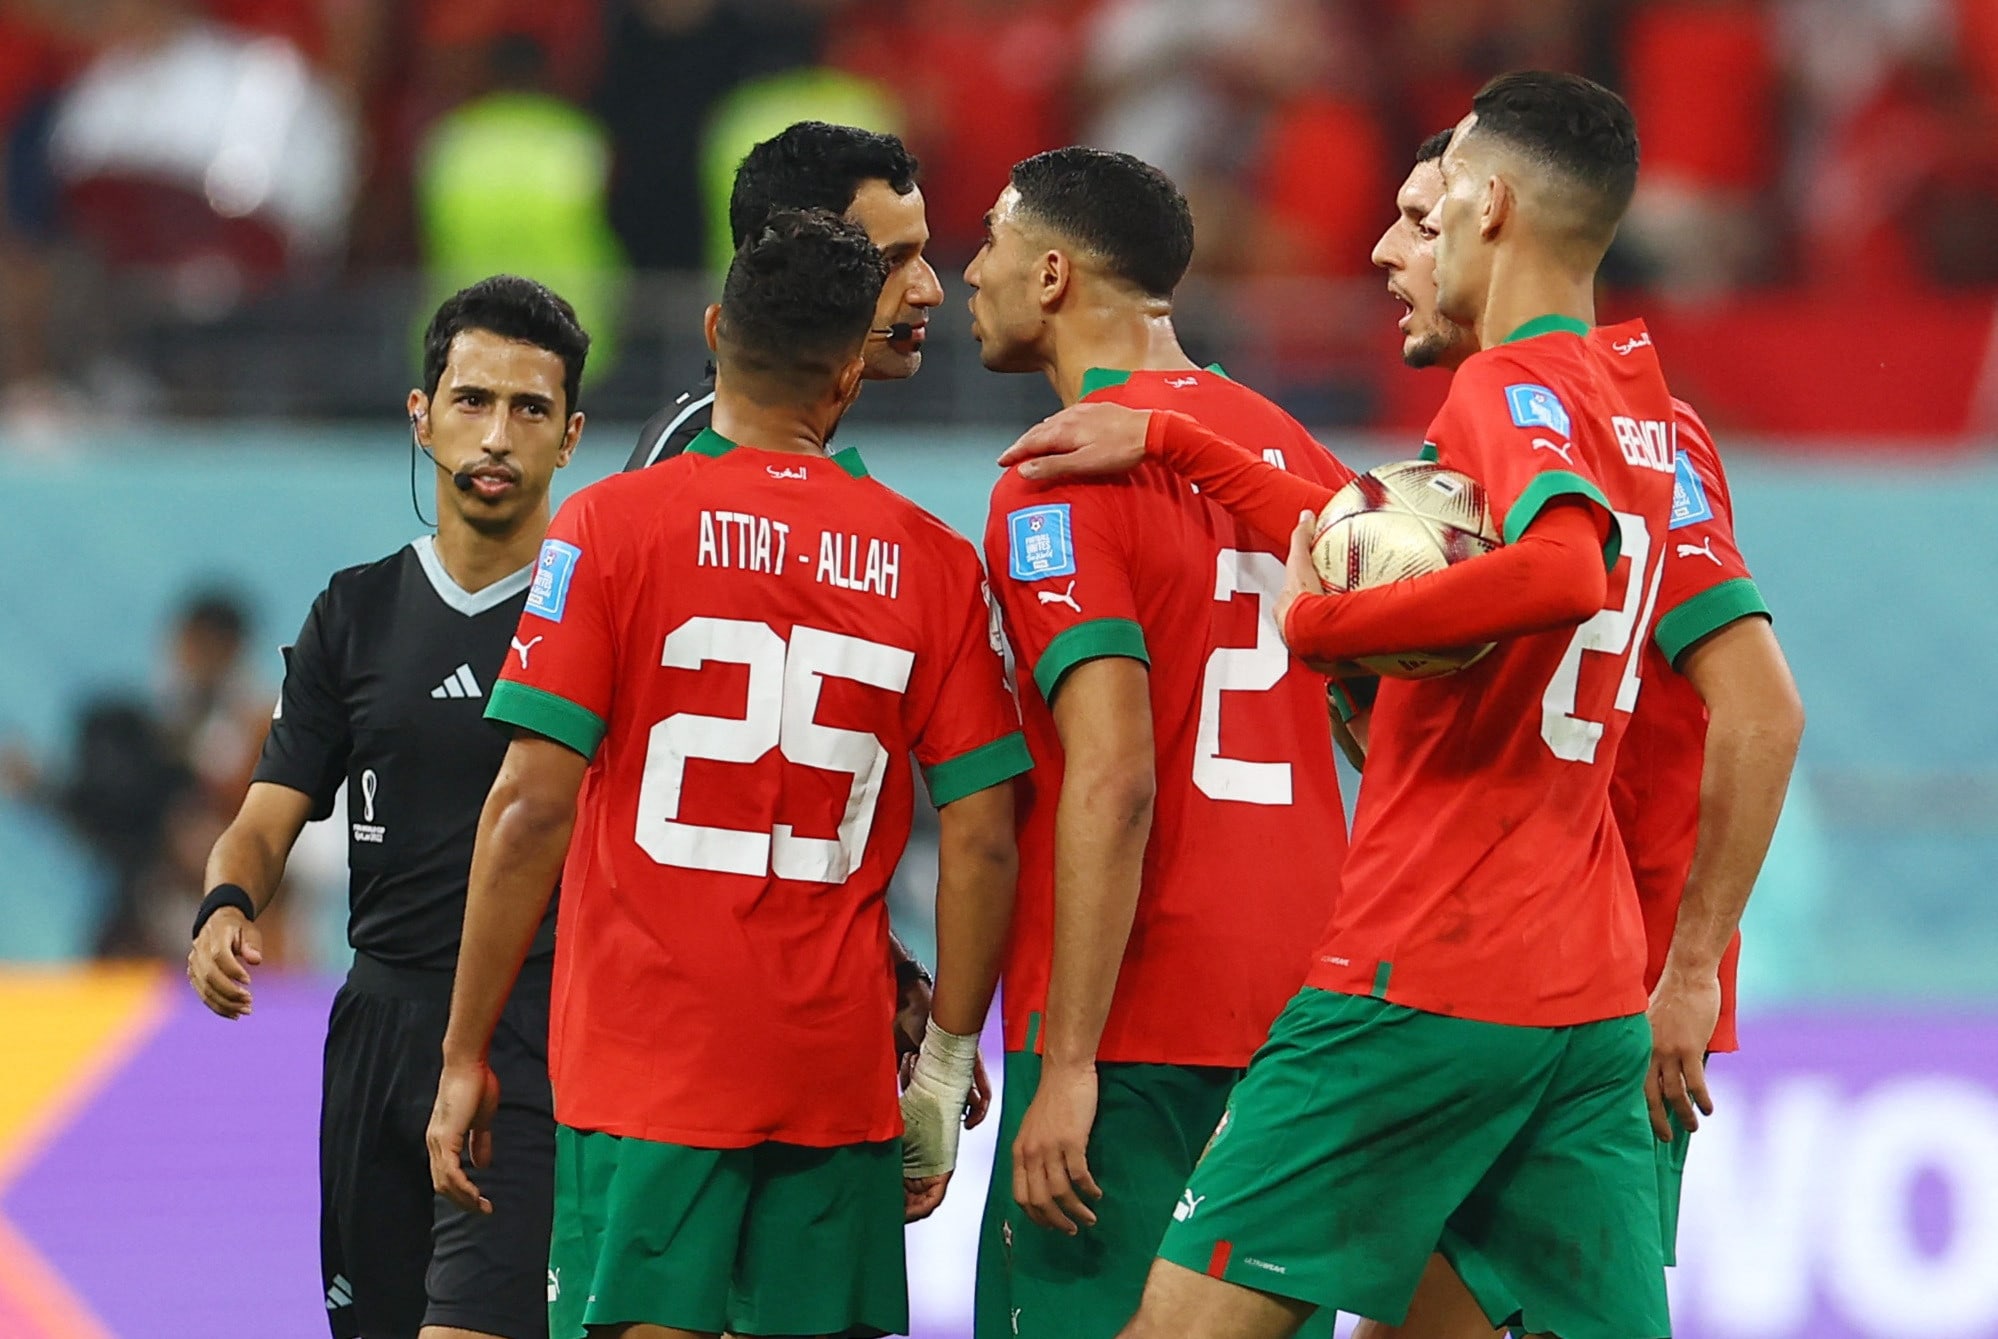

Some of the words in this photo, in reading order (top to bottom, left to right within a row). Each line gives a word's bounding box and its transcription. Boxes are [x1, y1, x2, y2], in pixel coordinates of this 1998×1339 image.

[698, 510, 789, 575] ATTIAT
[816, 531, 900, 599] ALLAH
[1192, 548, 1293, 805] 2
[634, 616, 916, 884] 25
